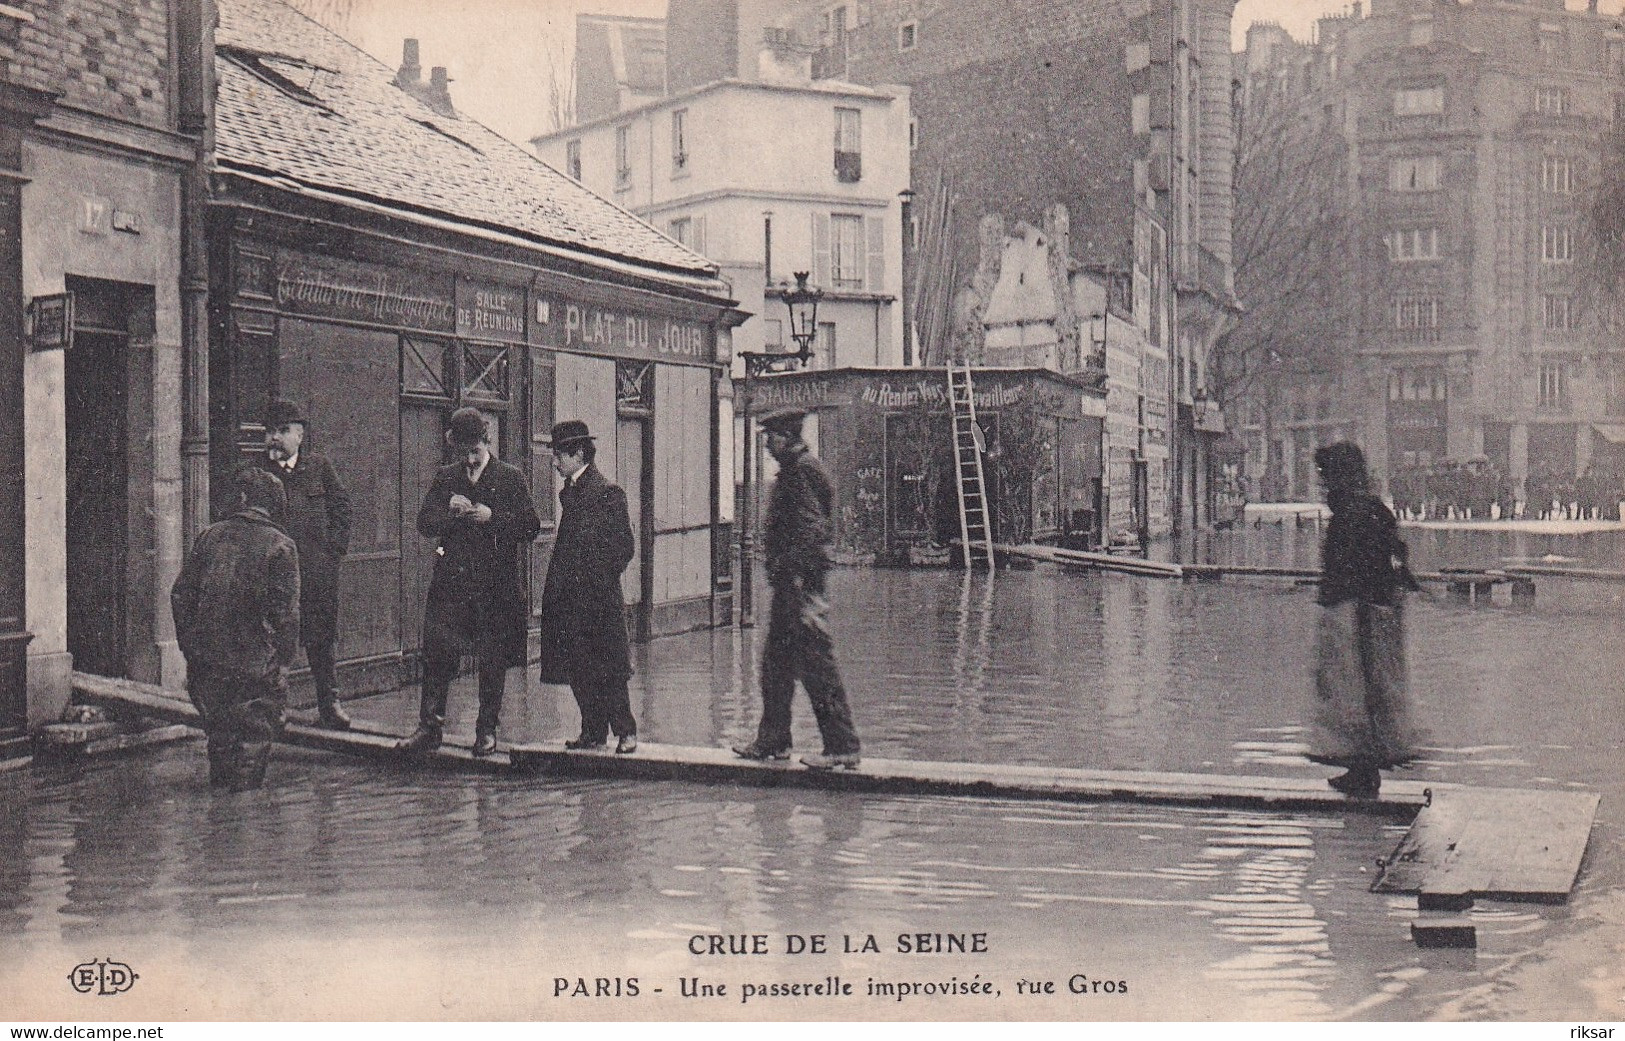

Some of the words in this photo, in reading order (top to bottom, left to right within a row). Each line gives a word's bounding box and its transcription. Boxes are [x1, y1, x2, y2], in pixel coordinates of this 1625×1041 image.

[476, 291, 507, 311] SALLE
[458, 308, 471, 326] DE
[565, 304, 616, 345] PLAT
[625, 316, 650, 348] DU
[658, 319, 702, 356] JOUR
